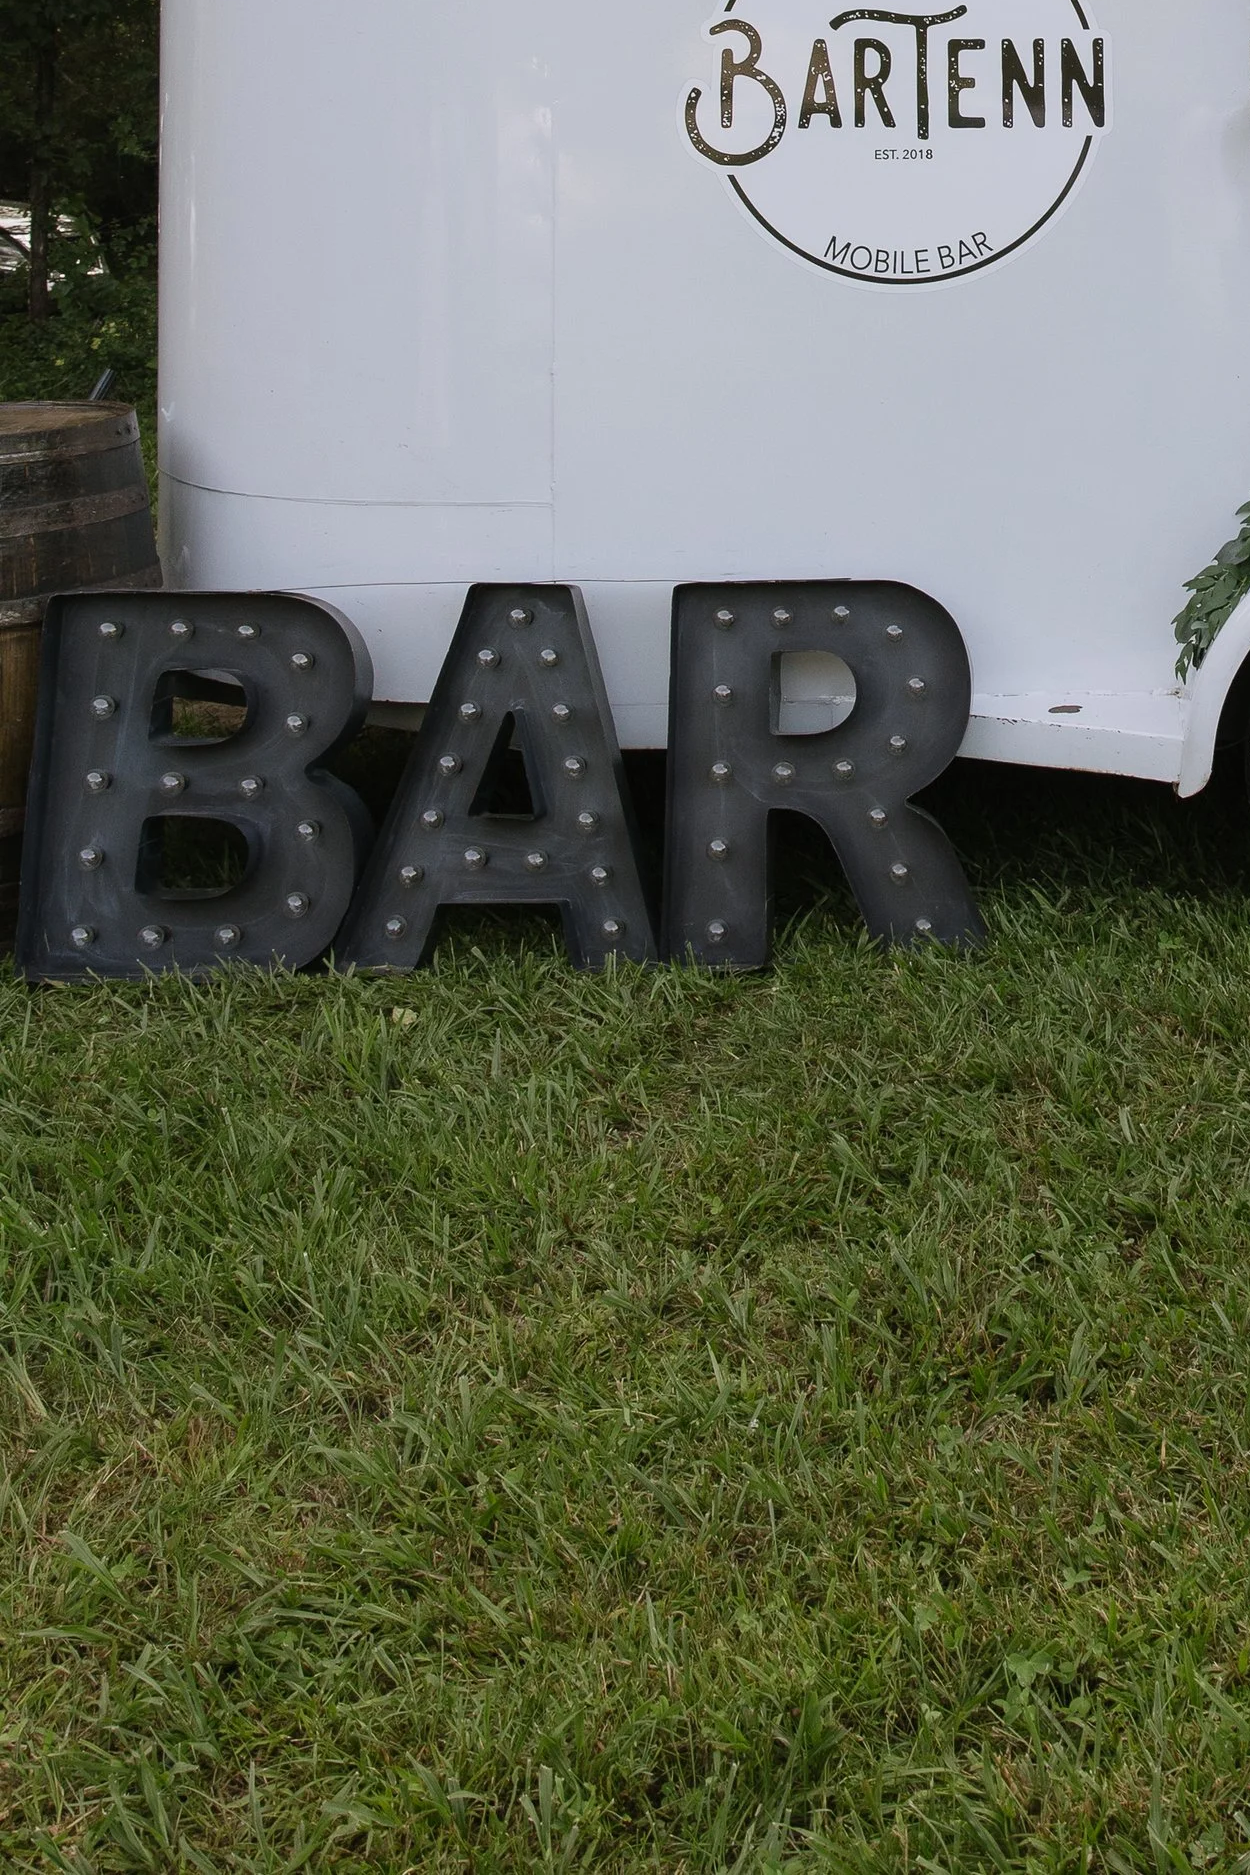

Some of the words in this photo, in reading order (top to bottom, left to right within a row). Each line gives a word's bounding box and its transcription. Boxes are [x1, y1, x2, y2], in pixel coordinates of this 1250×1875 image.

[873, 149, 900, 160] EST.
[902, 149, 934, 160] 2018
[823, 235, 931, 274] MOBILE
[937, 231, 993, 270] BAR
[16, 579, 987, 983] BAR
